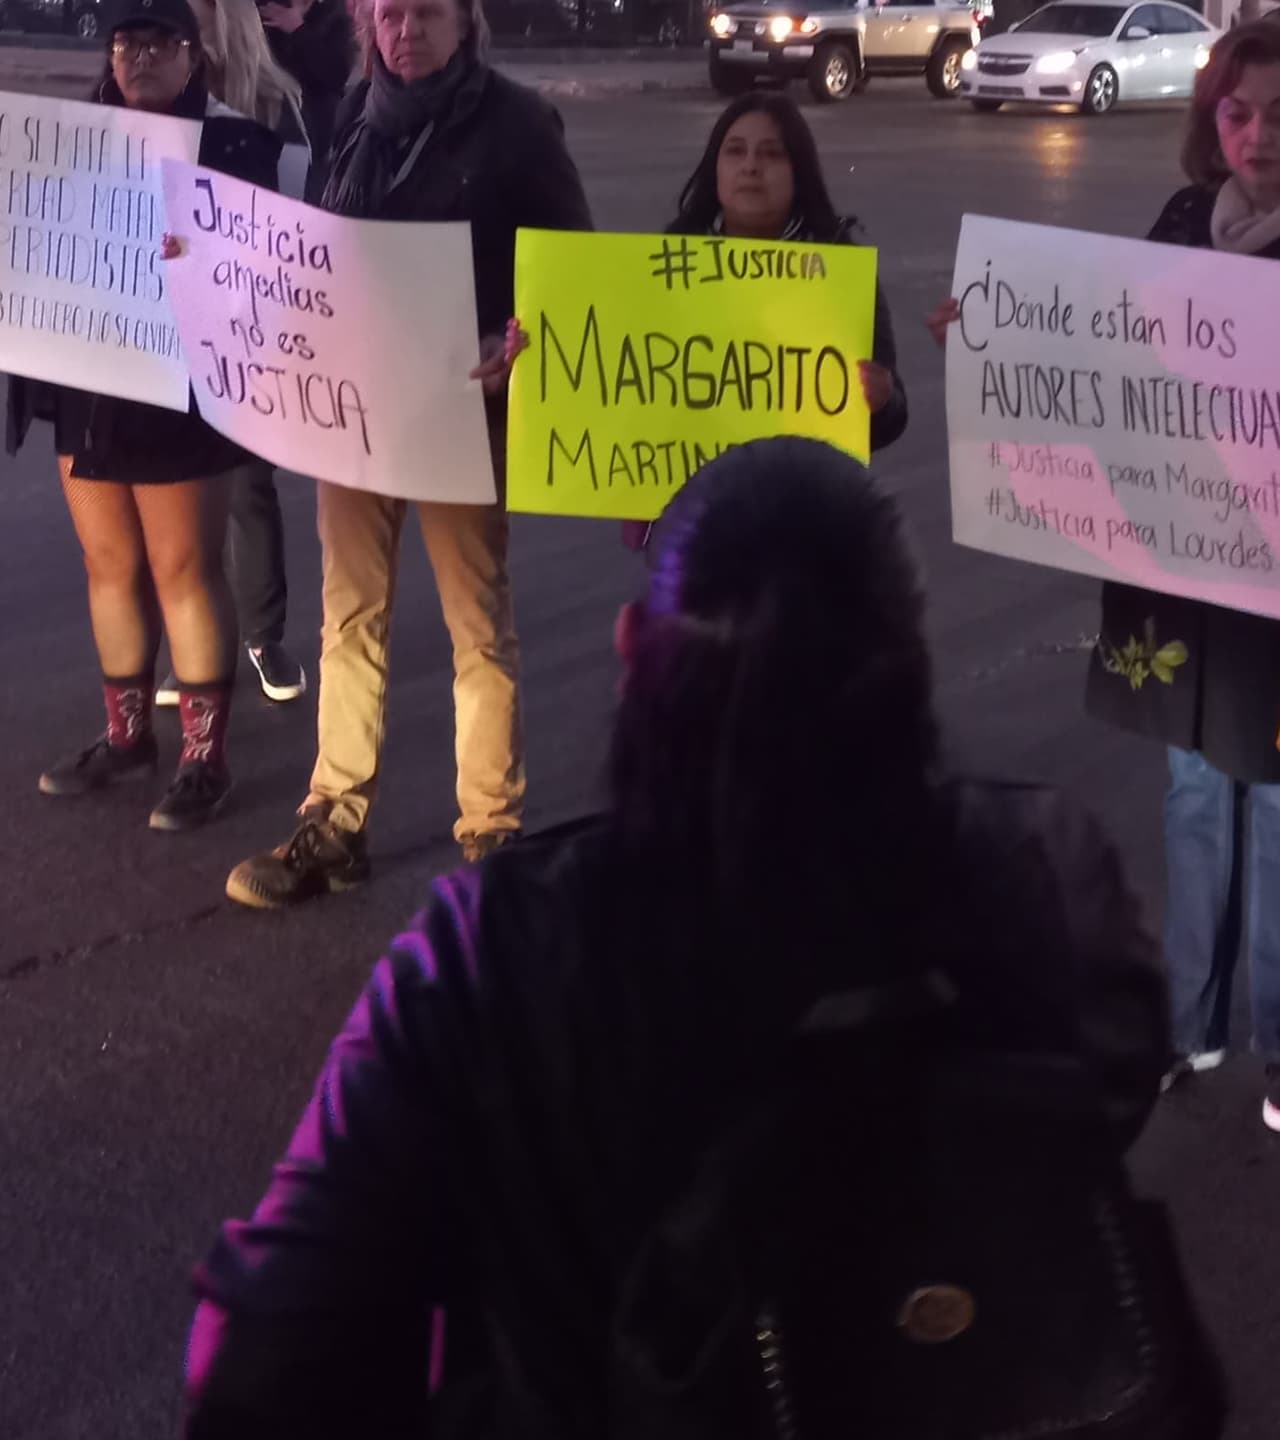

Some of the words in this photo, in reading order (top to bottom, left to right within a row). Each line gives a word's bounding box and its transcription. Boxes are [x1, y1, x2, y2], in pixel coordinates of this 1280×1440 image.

[53, 120, 113, 176] MATA
[192, 178, 334, 275] Justicia
[648, 237, 827, 291] #JUSTICIA
[86, 308, 111, 344] NO
[229, 317, 265, 359] no
[277, 331, 316, 361] es
[1090, 288, 1167, 347] estan
[1186, 296, 1238, 360] los
[540, 303, 850, 417] MARGARITO
[980, 358, 1106, 430] AUTORES
[200, 341, 372, 456] JUSTICIA
[547, 426, 740, 492] MARTIN
[987, 440, 1096, 482] #Justicia
[1106, 462, 1158, 497] para
[984, 486, 1096, 542] #Justicia
[1105, 517, 1158, 551] para
[1169, 519, 1274, 572] Lourdes
